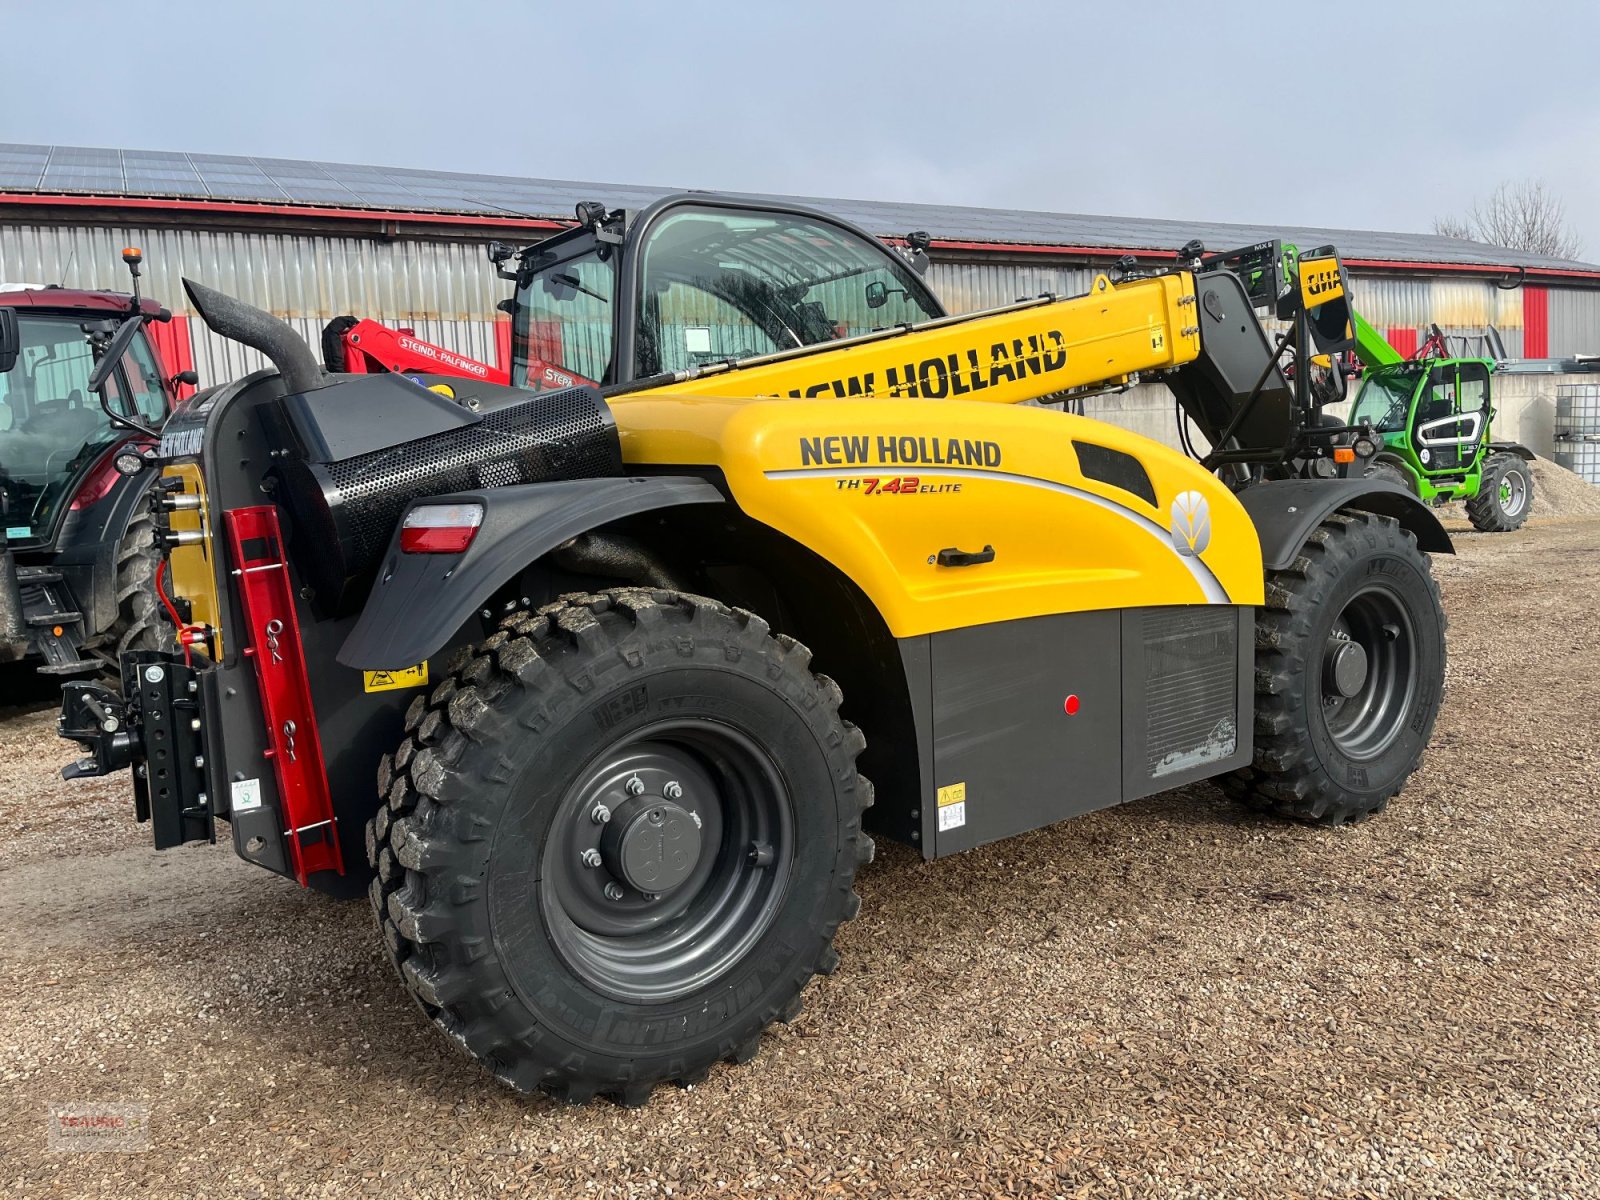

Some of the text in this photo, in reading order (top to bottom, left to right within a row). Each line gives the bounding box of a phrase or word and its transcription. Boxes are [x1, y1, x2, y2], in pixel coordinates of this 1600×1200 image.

[400, 337, 488, 376] STEINDL-PALFINGER
[886, 330, 1067, 399] HOLLAND
[800, 436, 1001, 467] NEW HOLLAND
[837, 477, 962, 495] TH 7.42 ELITE
